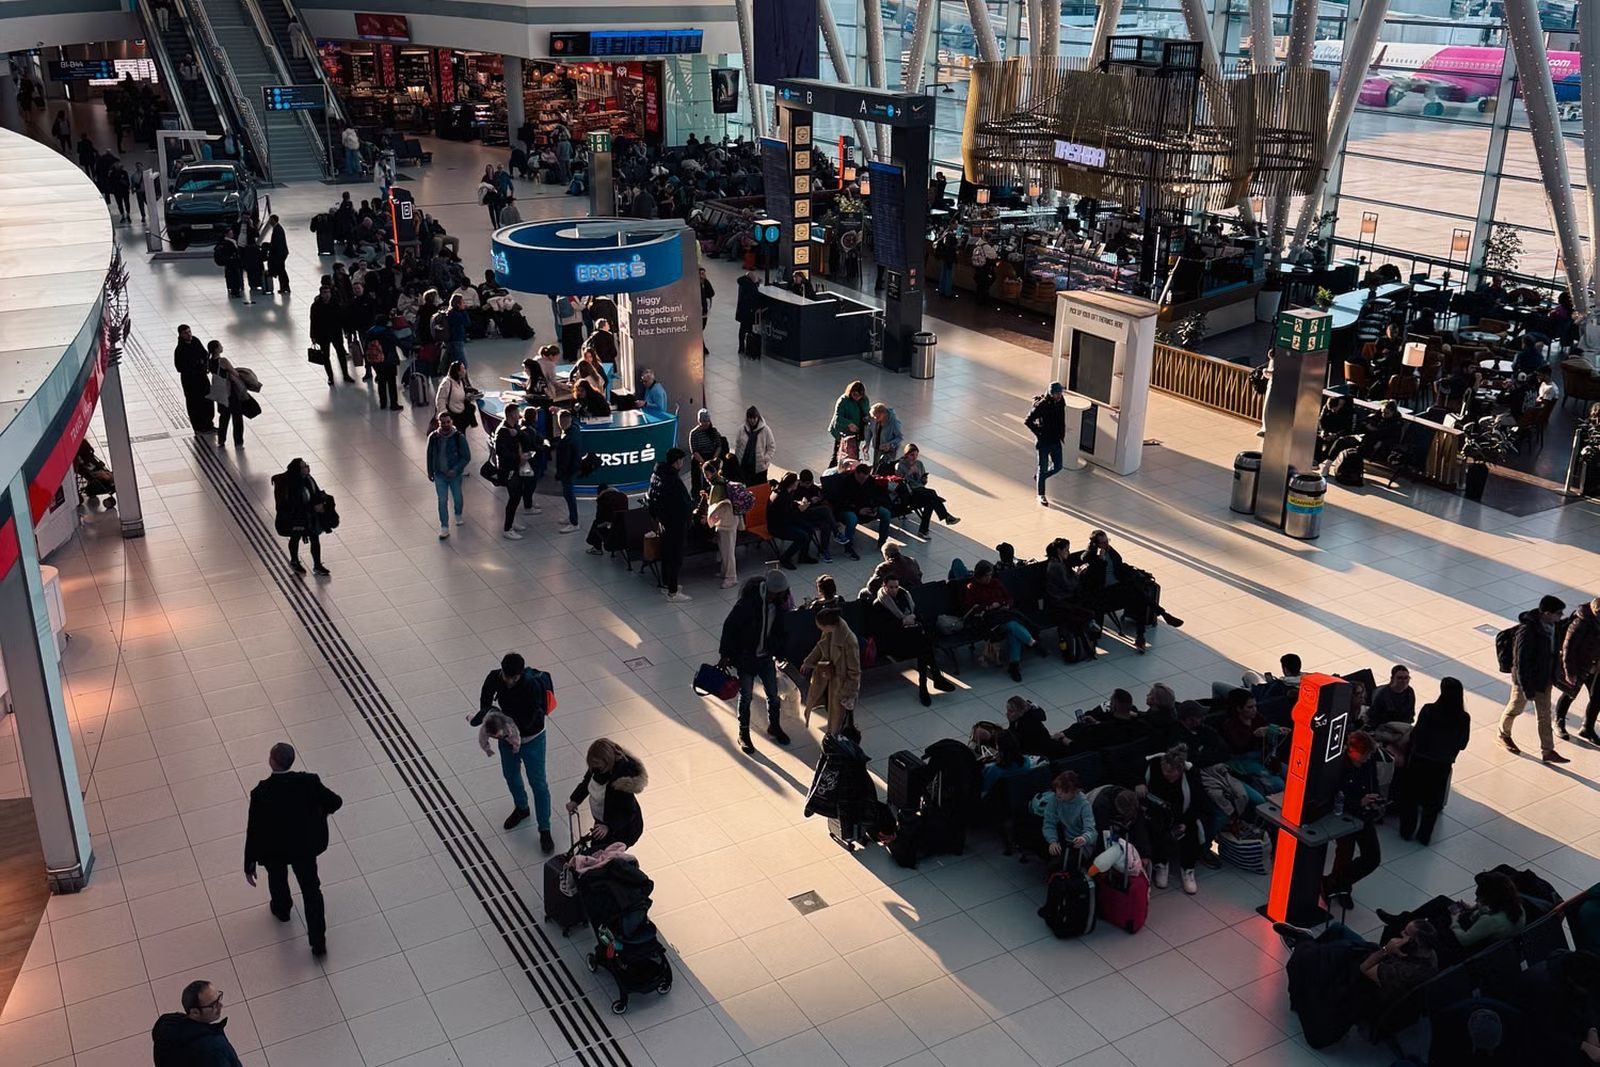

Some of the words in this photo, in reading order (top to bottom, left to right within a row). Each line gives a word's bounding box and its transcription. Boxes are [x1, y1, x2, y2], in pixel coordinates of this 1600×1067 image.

[806, 91, 813, 104] B
[859, 99, 867, 114] A
[577, 262, 629, 282] ERSTE
[636, 296, 661, 306] Higgy
[650, 316, 672, 325] Erste
[673, 314, 688, 322] már
[638, 328, 654, 336] hisz
[656, 324, 689, 335] benned.
[595, 451, 639, 466] RSTE
